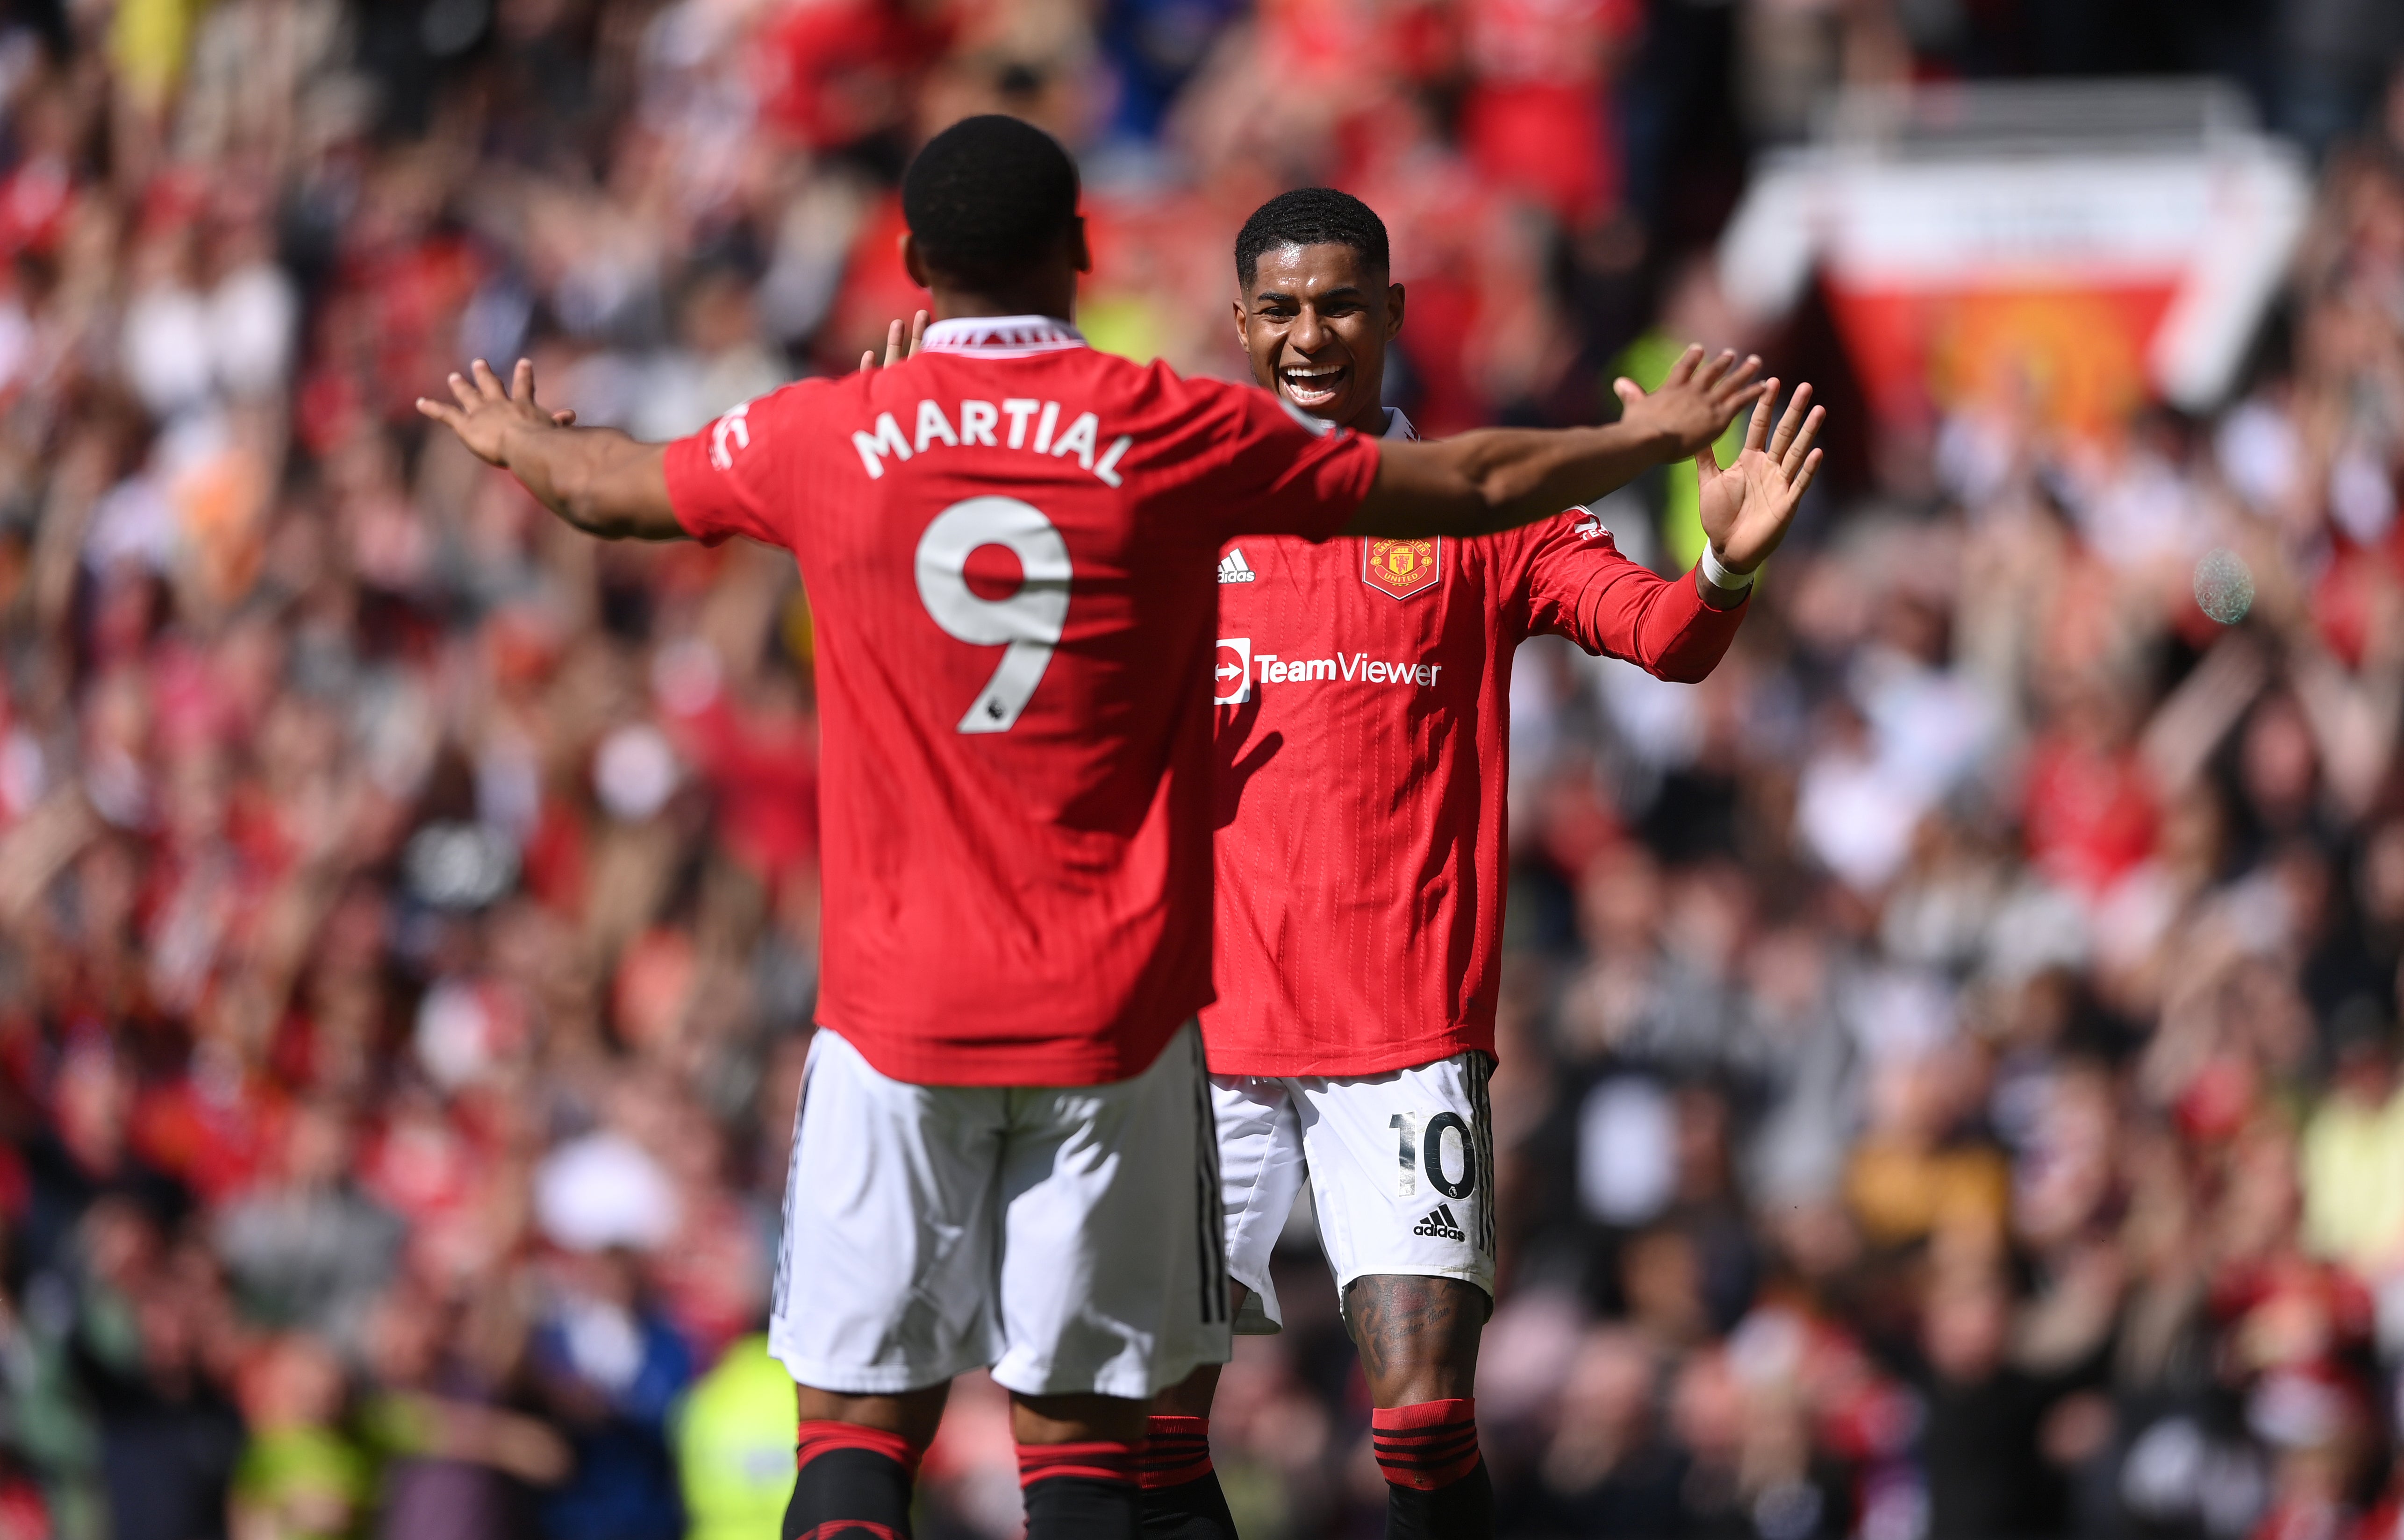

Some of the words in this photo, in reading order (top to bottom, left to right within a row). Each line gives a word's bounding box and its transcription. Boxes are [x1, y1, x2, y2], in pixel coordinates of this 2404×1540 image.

[851, 398, 1133, 489] MARTIAL
[1217, 570, 1254, 583] didas
[1384, 573, 1418, 583] UNITED
[914, 494, 1073, 734] 9
[1254, 652, 1442, 687] TeamViewer
[1389, 1111, 1477, 1200] 10
[1413, 1223, 1466, 1242] adidas
